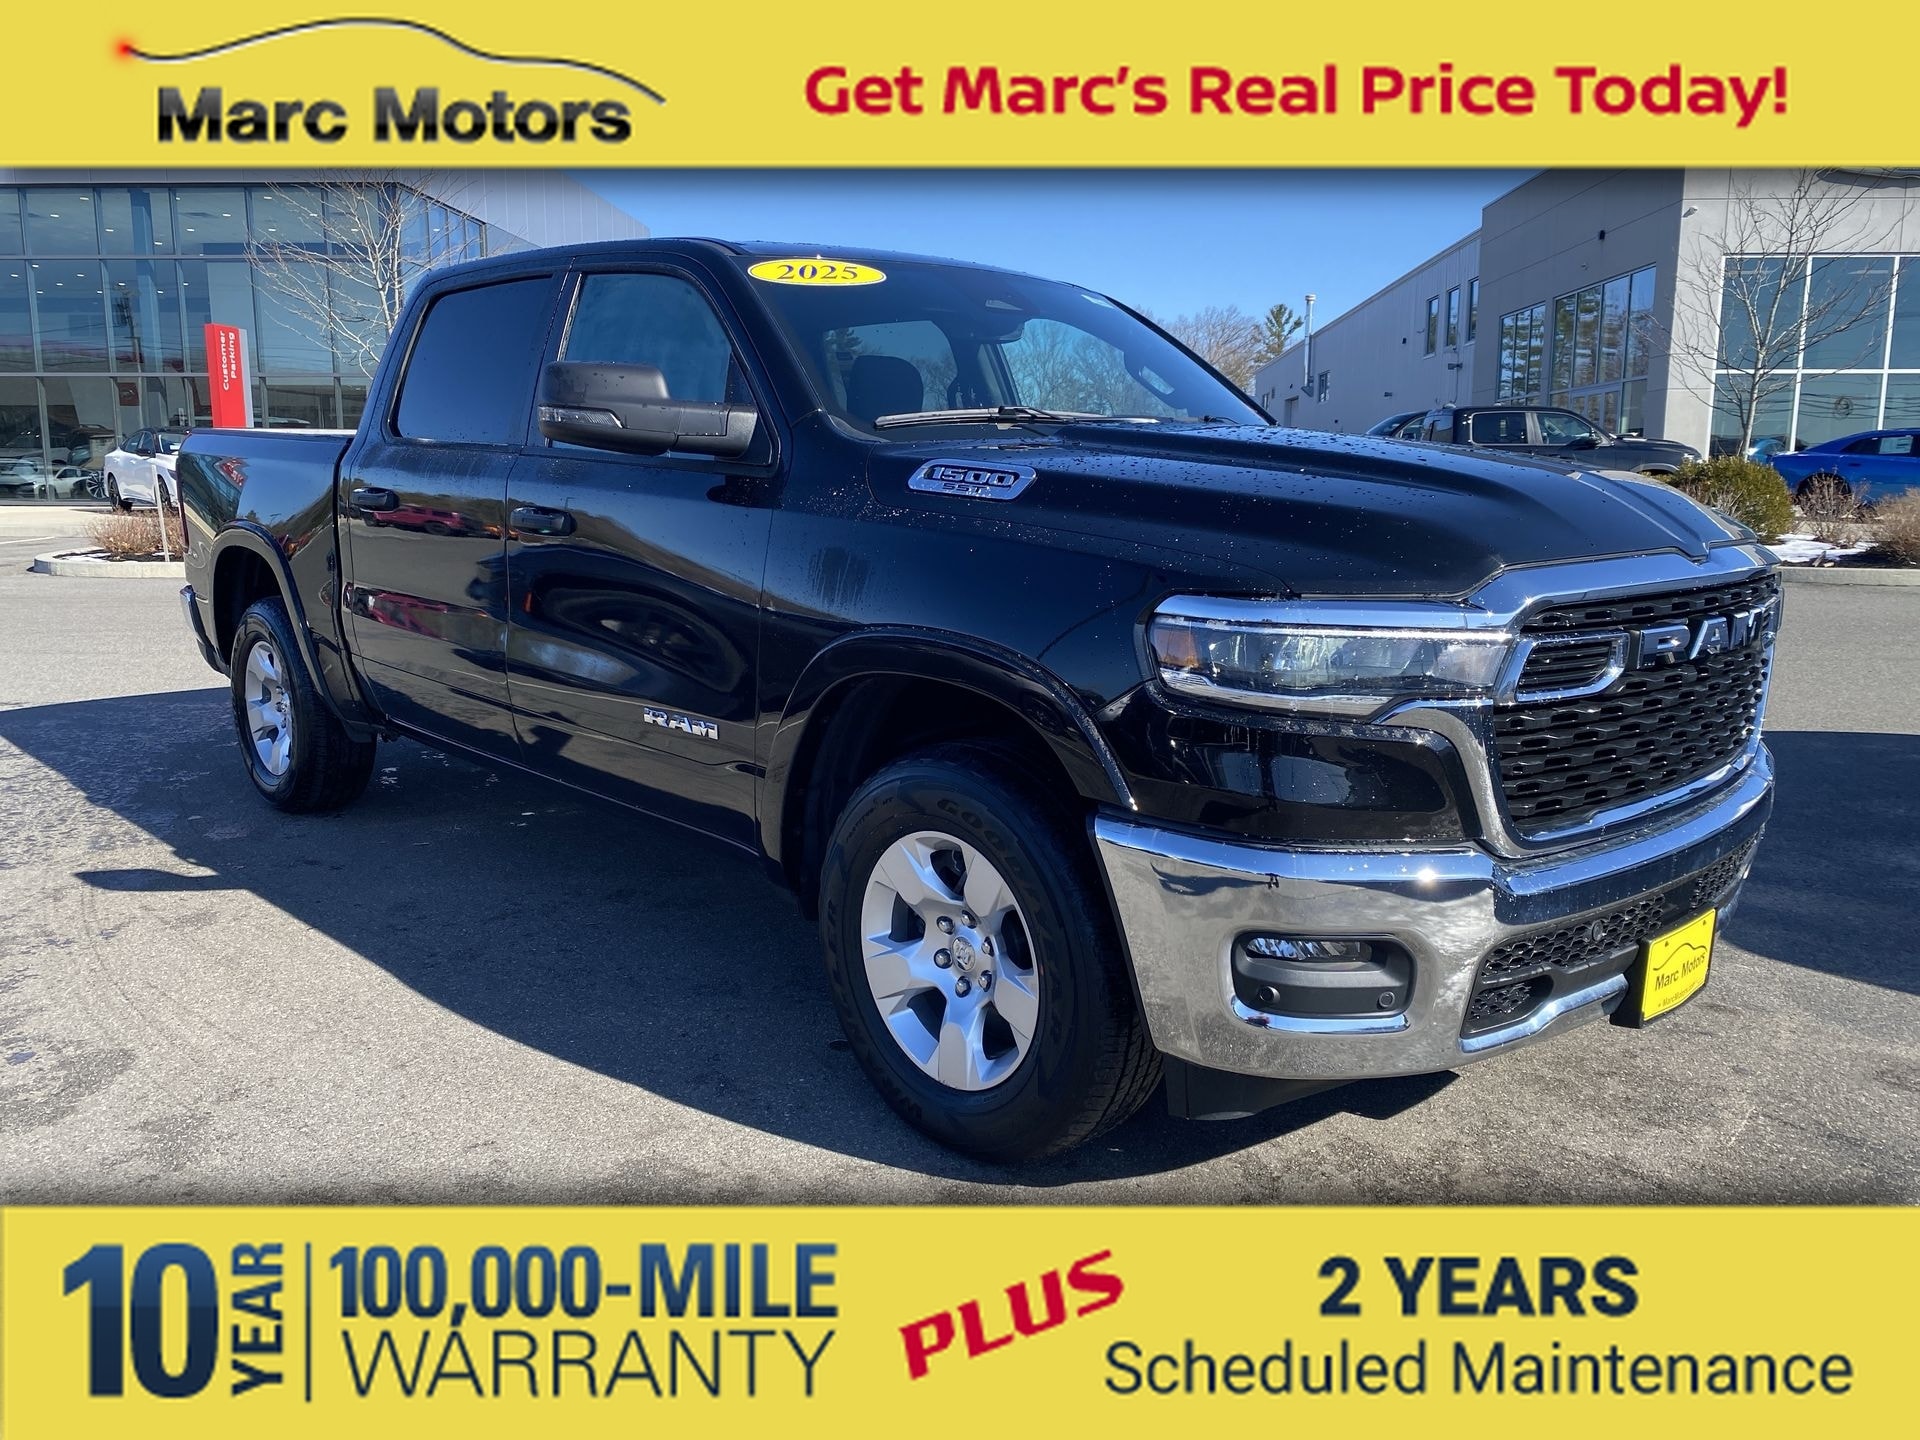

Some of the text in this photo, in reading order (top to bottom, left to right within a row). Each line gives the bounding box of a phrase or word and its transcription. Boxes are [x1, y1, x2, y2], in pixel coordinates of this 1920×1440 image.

[777, 264, 858, 280] 2025
[220, 330, 230, 391] Customer
[229, 332, 238, 379] Parking
[932, 466, 1015, 486] 1500
[1636, 606, 1763, 669] RAM
[643, 707, 718, 740] RAM
[1654, 952, 1706, 992] Marc Motors
